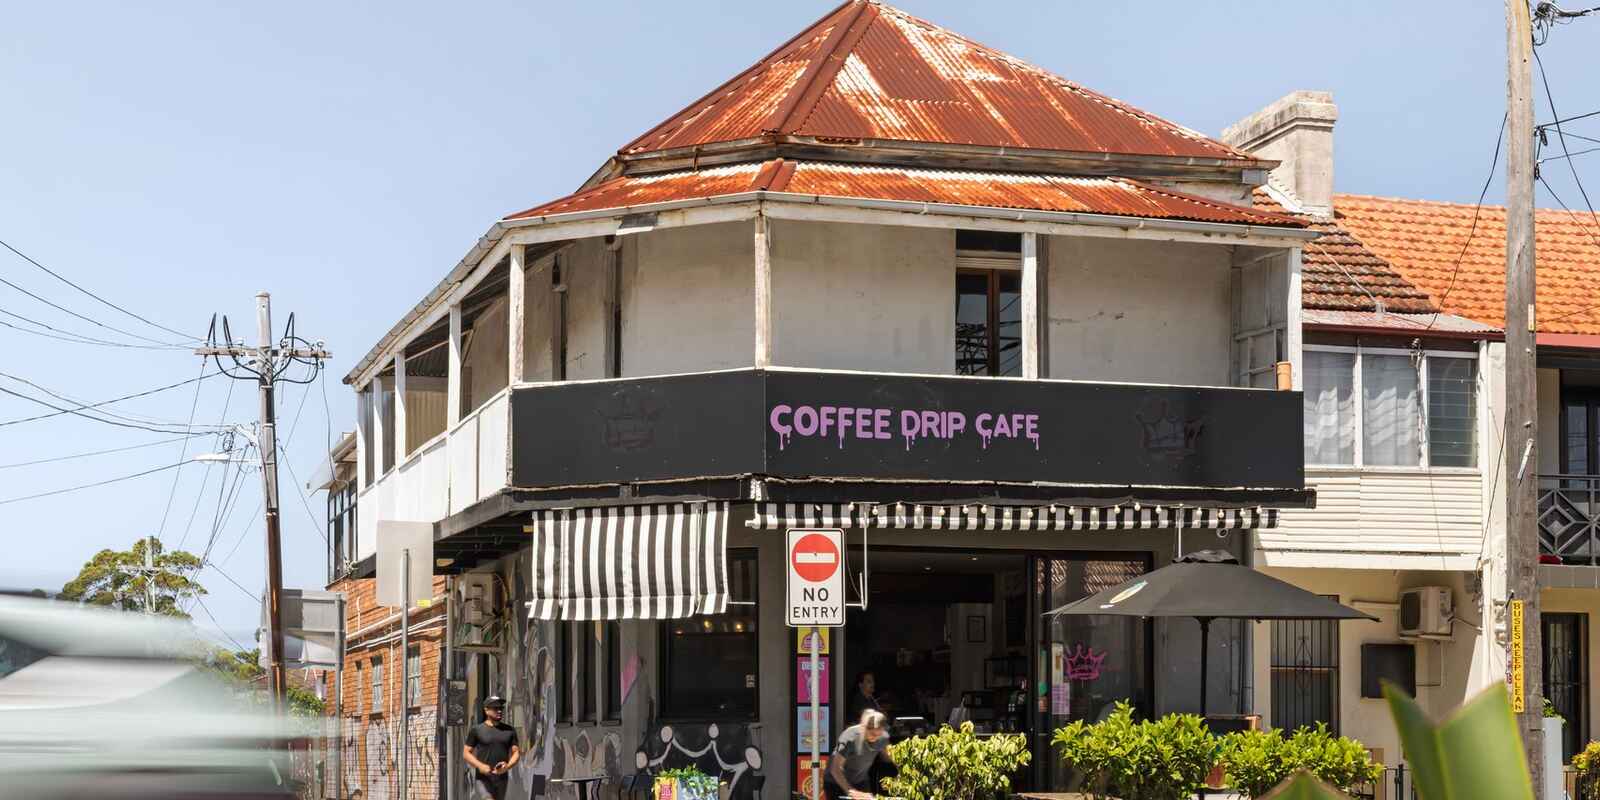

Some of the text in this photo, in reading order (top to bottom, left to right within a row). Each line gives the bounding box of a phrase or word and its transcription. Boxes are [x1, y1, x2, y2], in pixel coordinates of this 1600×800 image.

[770, 404, 1039, 451] COFFEE DRIP CAFE
[803, 587, 829, 602] NO
[793, 606, 839, 619] ENTRY
[1513, 602, 1521, 640] BUSES
